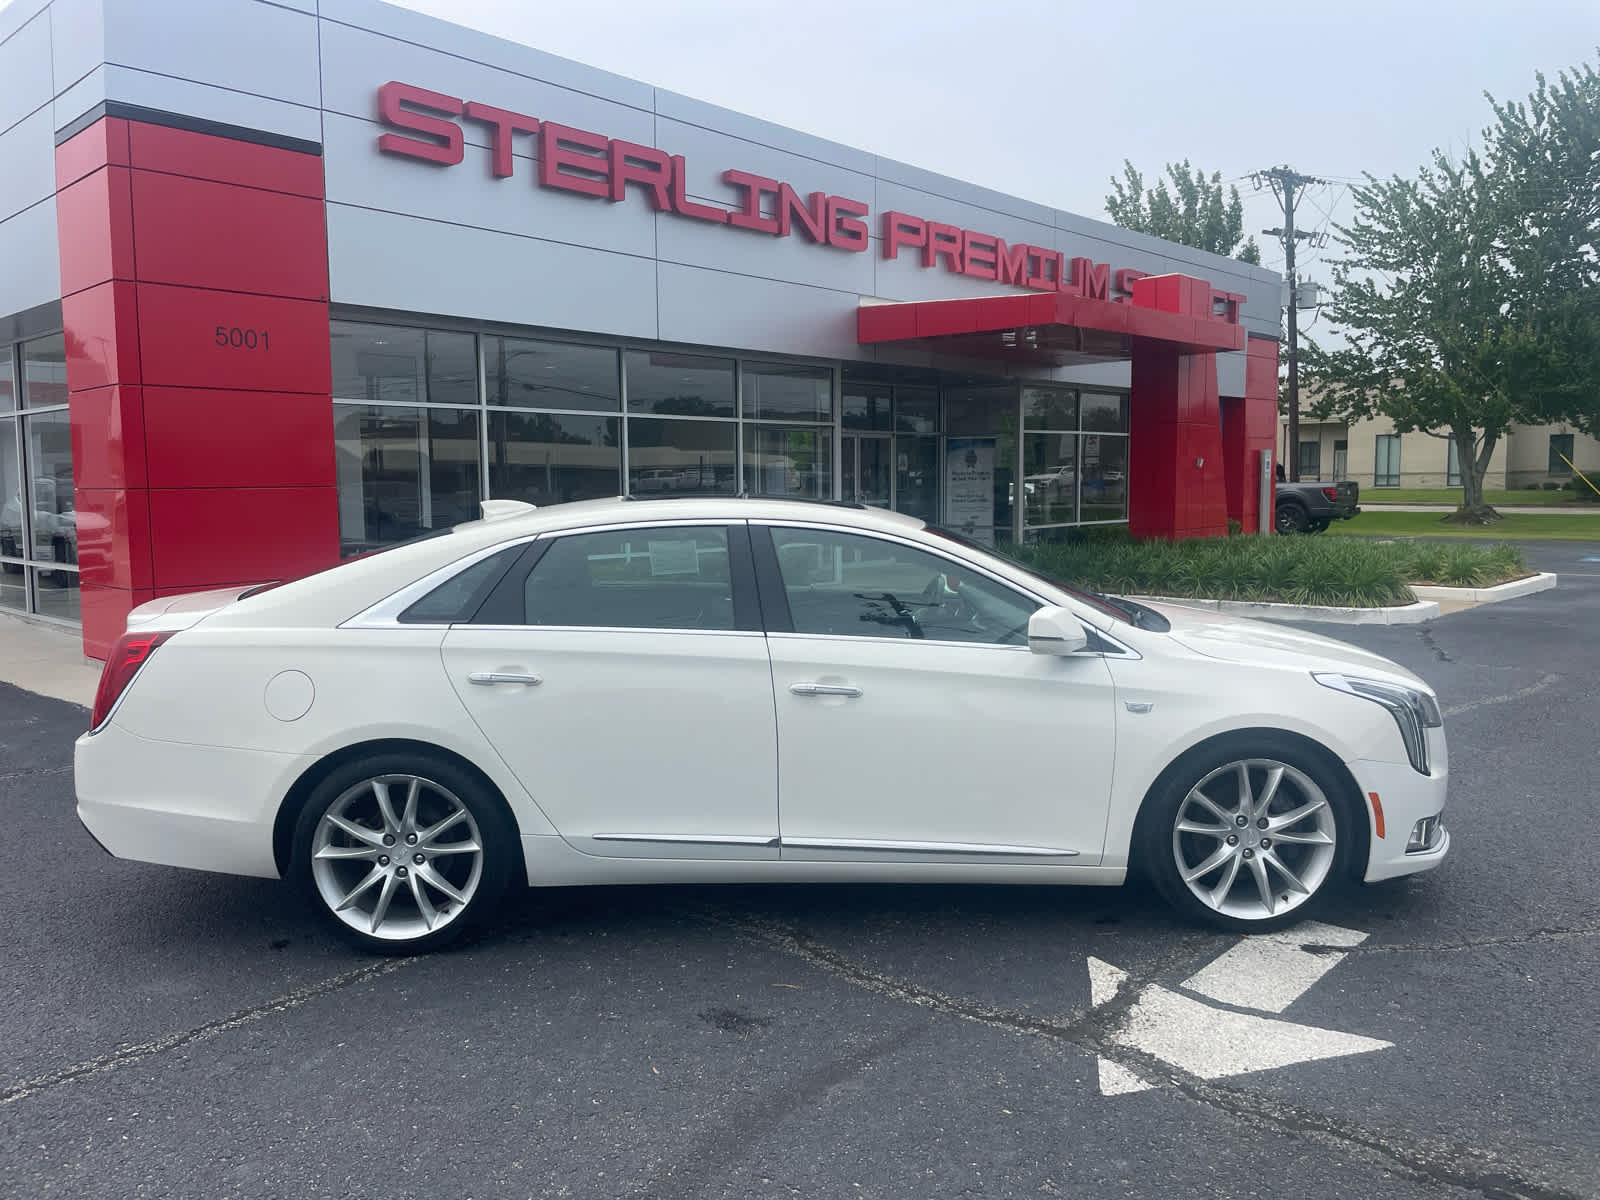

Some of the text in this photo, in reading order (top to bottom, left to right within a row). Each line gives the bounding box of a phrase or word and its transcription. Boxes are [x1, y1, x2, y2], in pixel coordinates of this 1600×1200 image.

[378, 81, 869, 252] STERLING
[882, 211, 1110, 301] PREMIUM
[215, 325, 269, 351] 5001
